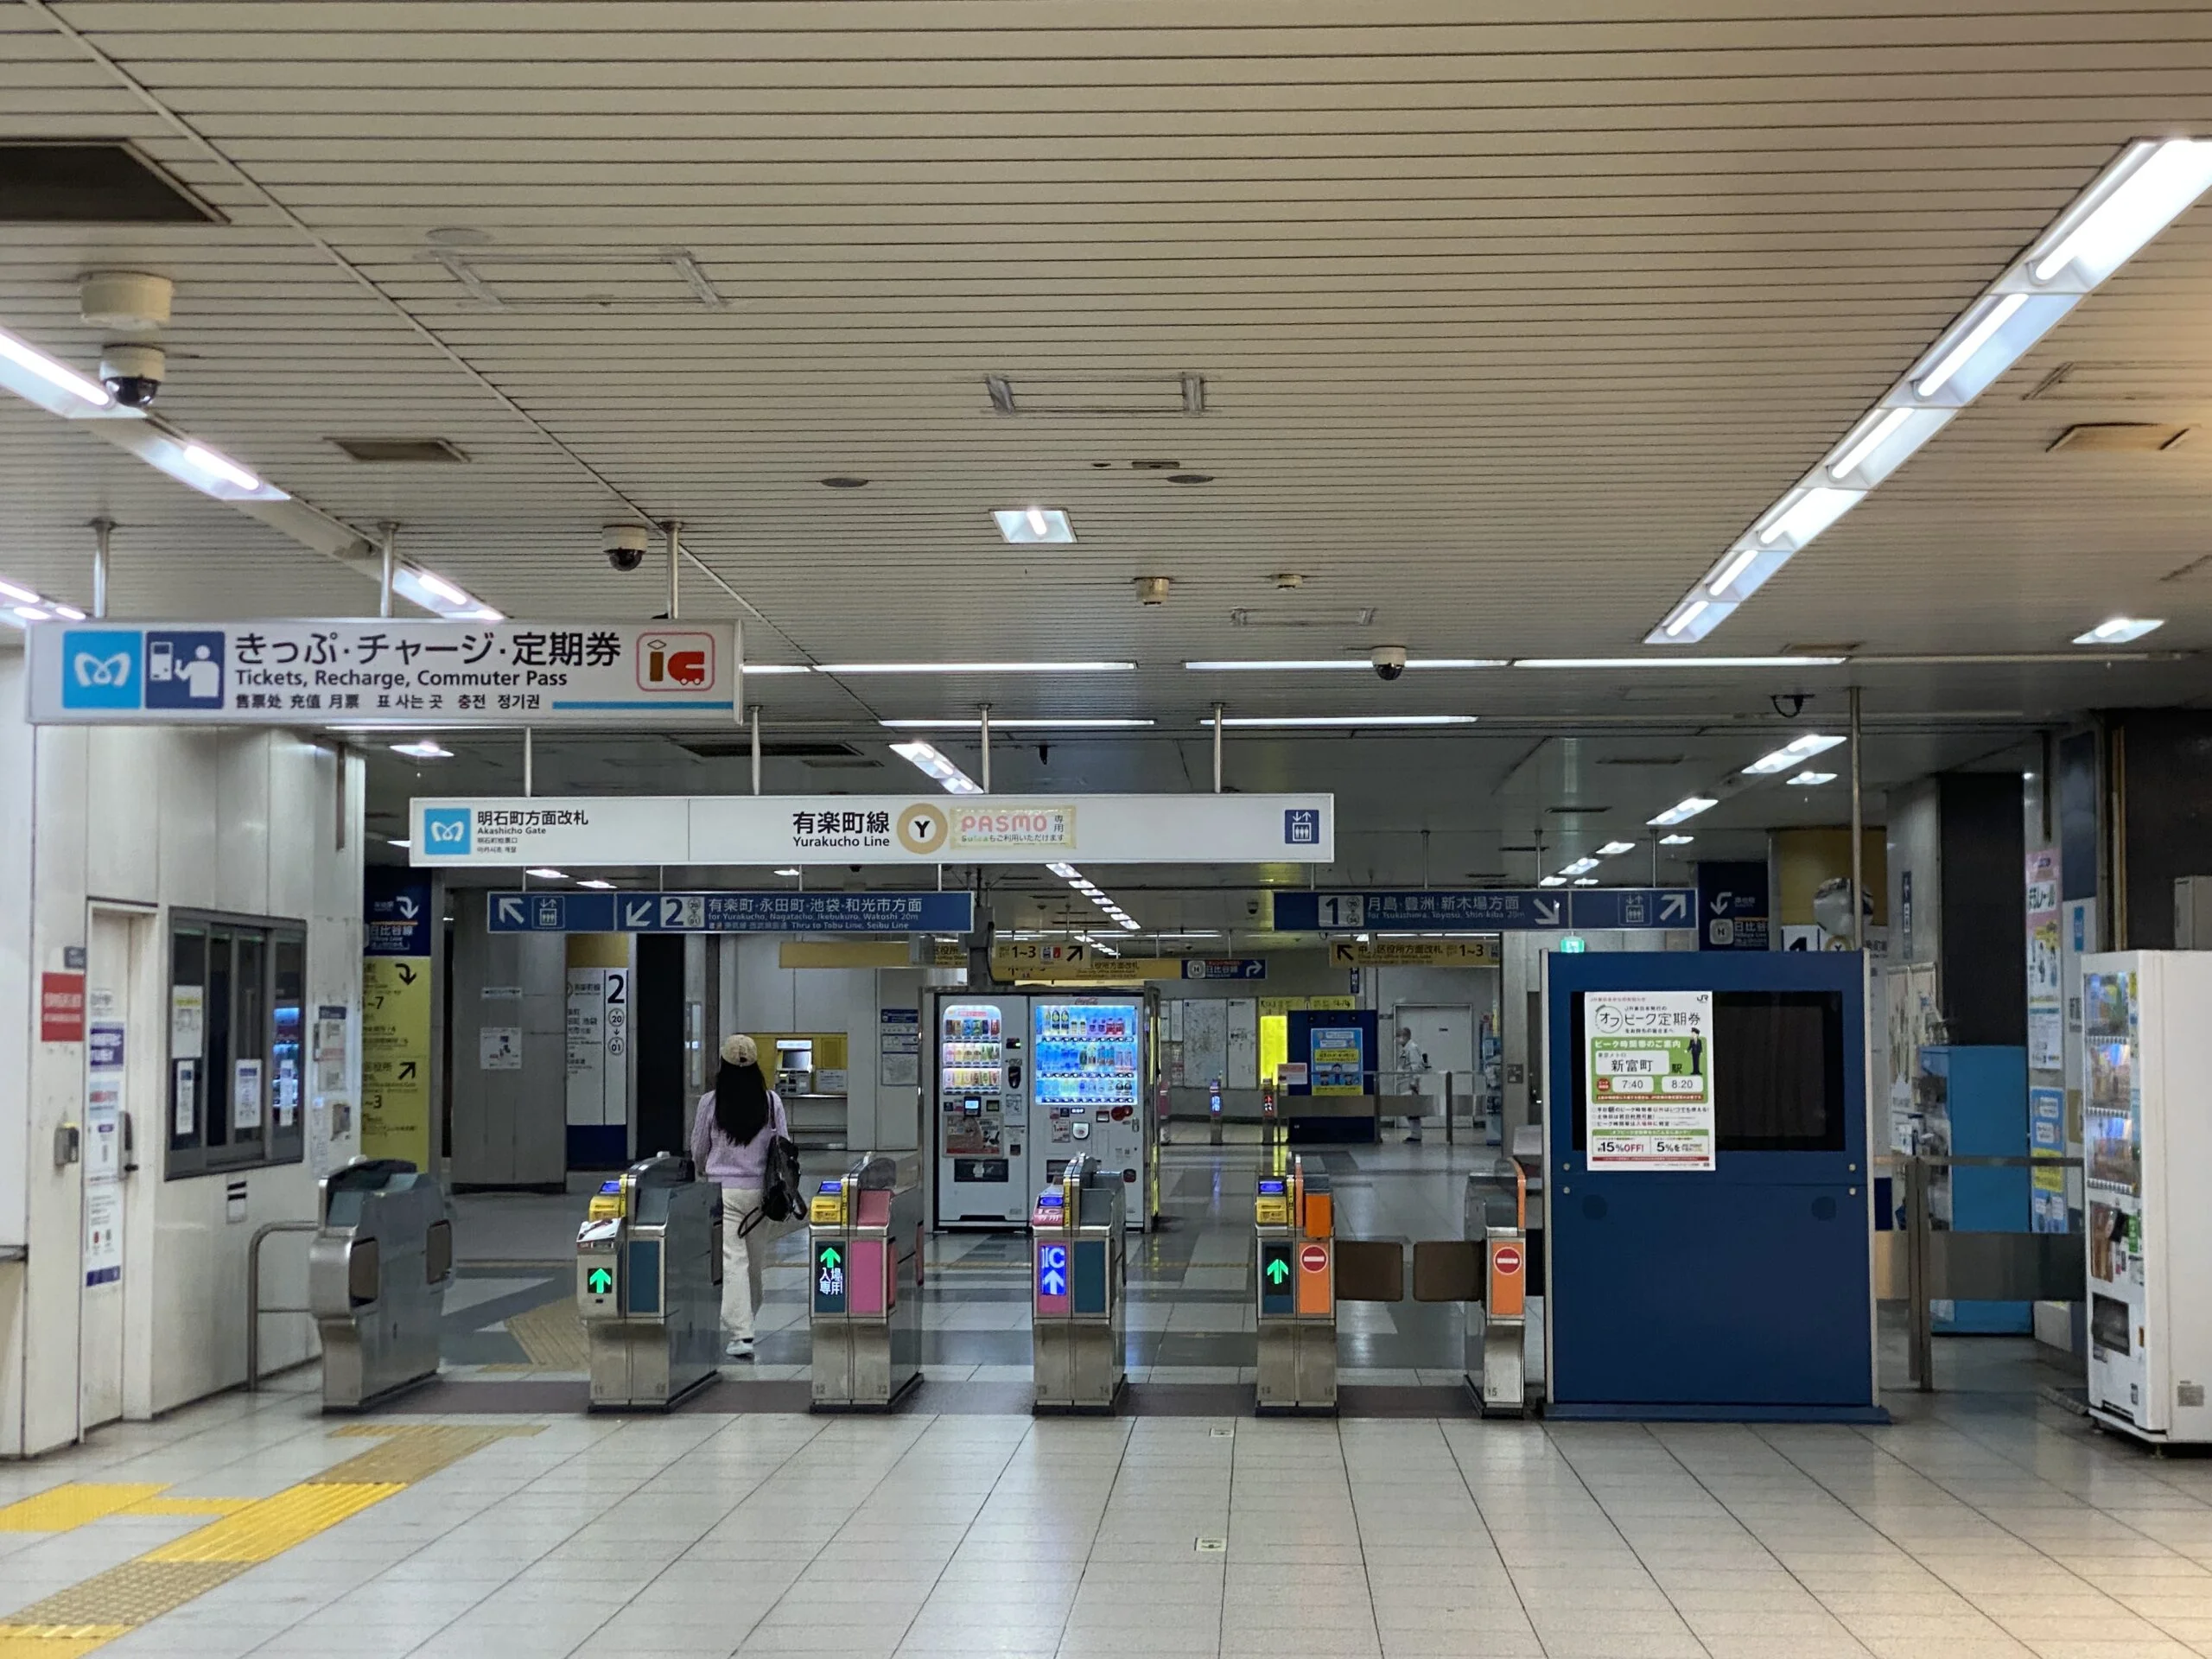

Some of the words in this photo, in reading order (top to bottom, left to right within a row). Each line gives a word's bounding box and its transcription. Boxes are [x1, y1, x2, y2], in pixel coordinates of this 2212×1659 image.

[235, 669, 308, 687] Tickets,
[315, 669, 410, 690] Recharge,
[417, 670, 520, 686] Commuter
[526, 670, 568, 686] Pass
[328, 694, 359, 709] 月票
[377, 694, 391, 709] 표
[396, 694, 423, 709] 사는
[429, 694, 442, 709] 곳
[458, 694, 486, 709] 충전
[498, 694, 540, 709] 정기권
[477, 810, 588, 826] 明石町方面改札
[792, 810, 890, 834] 有楽町線
[961, 814, 1047, 832] PASMO
[914, 821, 930, 838] Y
[793, 836, 860, 847] Yurakucho
[864, 836, 890, 846] Line
[664, 898, 684, 926] 2
[1325, 897, 1338, 925] 1
[1358, 944, 1443, 954] 中区役所方面改札
[607, 974, 625, 1003] 2
[1611, 1059, 1653, 1072] 新富町
[1671, 1064, 1682, 1074] 駅
[1622, 1080, 1643, 1089] 7:40
[1671, 1080, 1693, 1089] 8:20
[1042, 1247, 1065, 1268] IC
